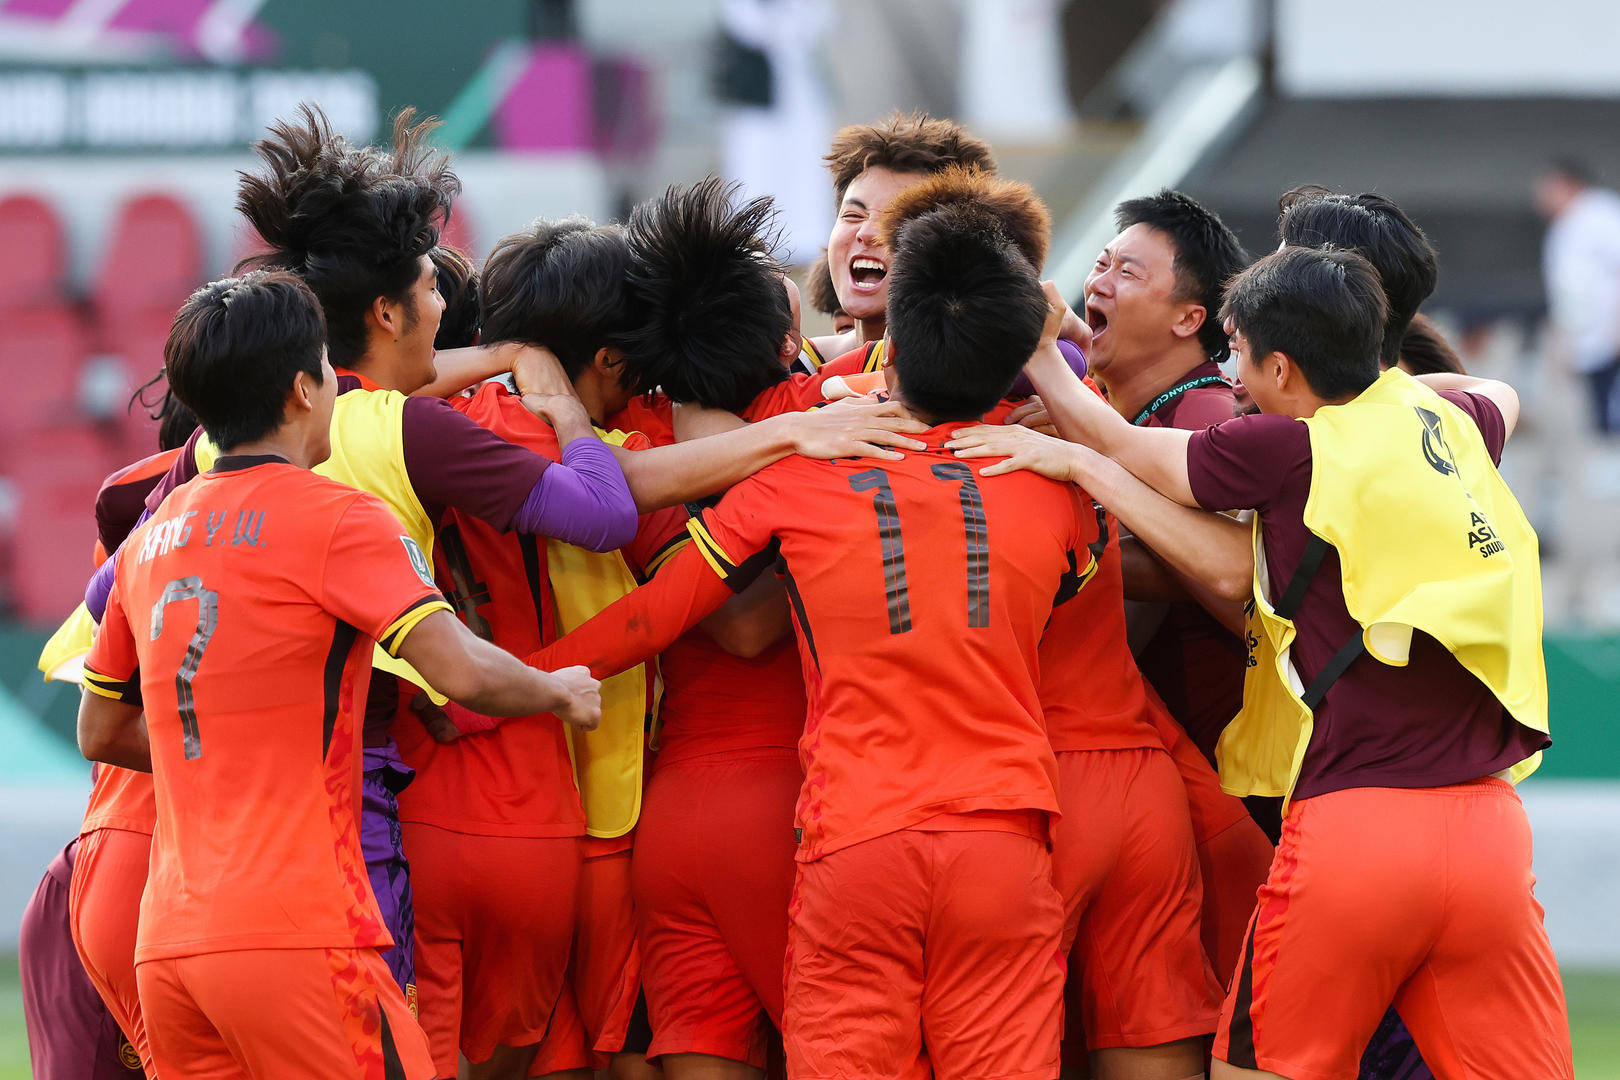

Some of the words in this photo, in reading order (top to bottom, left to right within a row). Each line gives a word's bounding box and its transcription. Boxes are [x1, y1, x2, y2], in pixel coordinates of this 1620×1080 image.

[139, 510, 199, 565] XIANG
[848, 462, 990, 635] 11
[150, 576, 218, 760] 7
